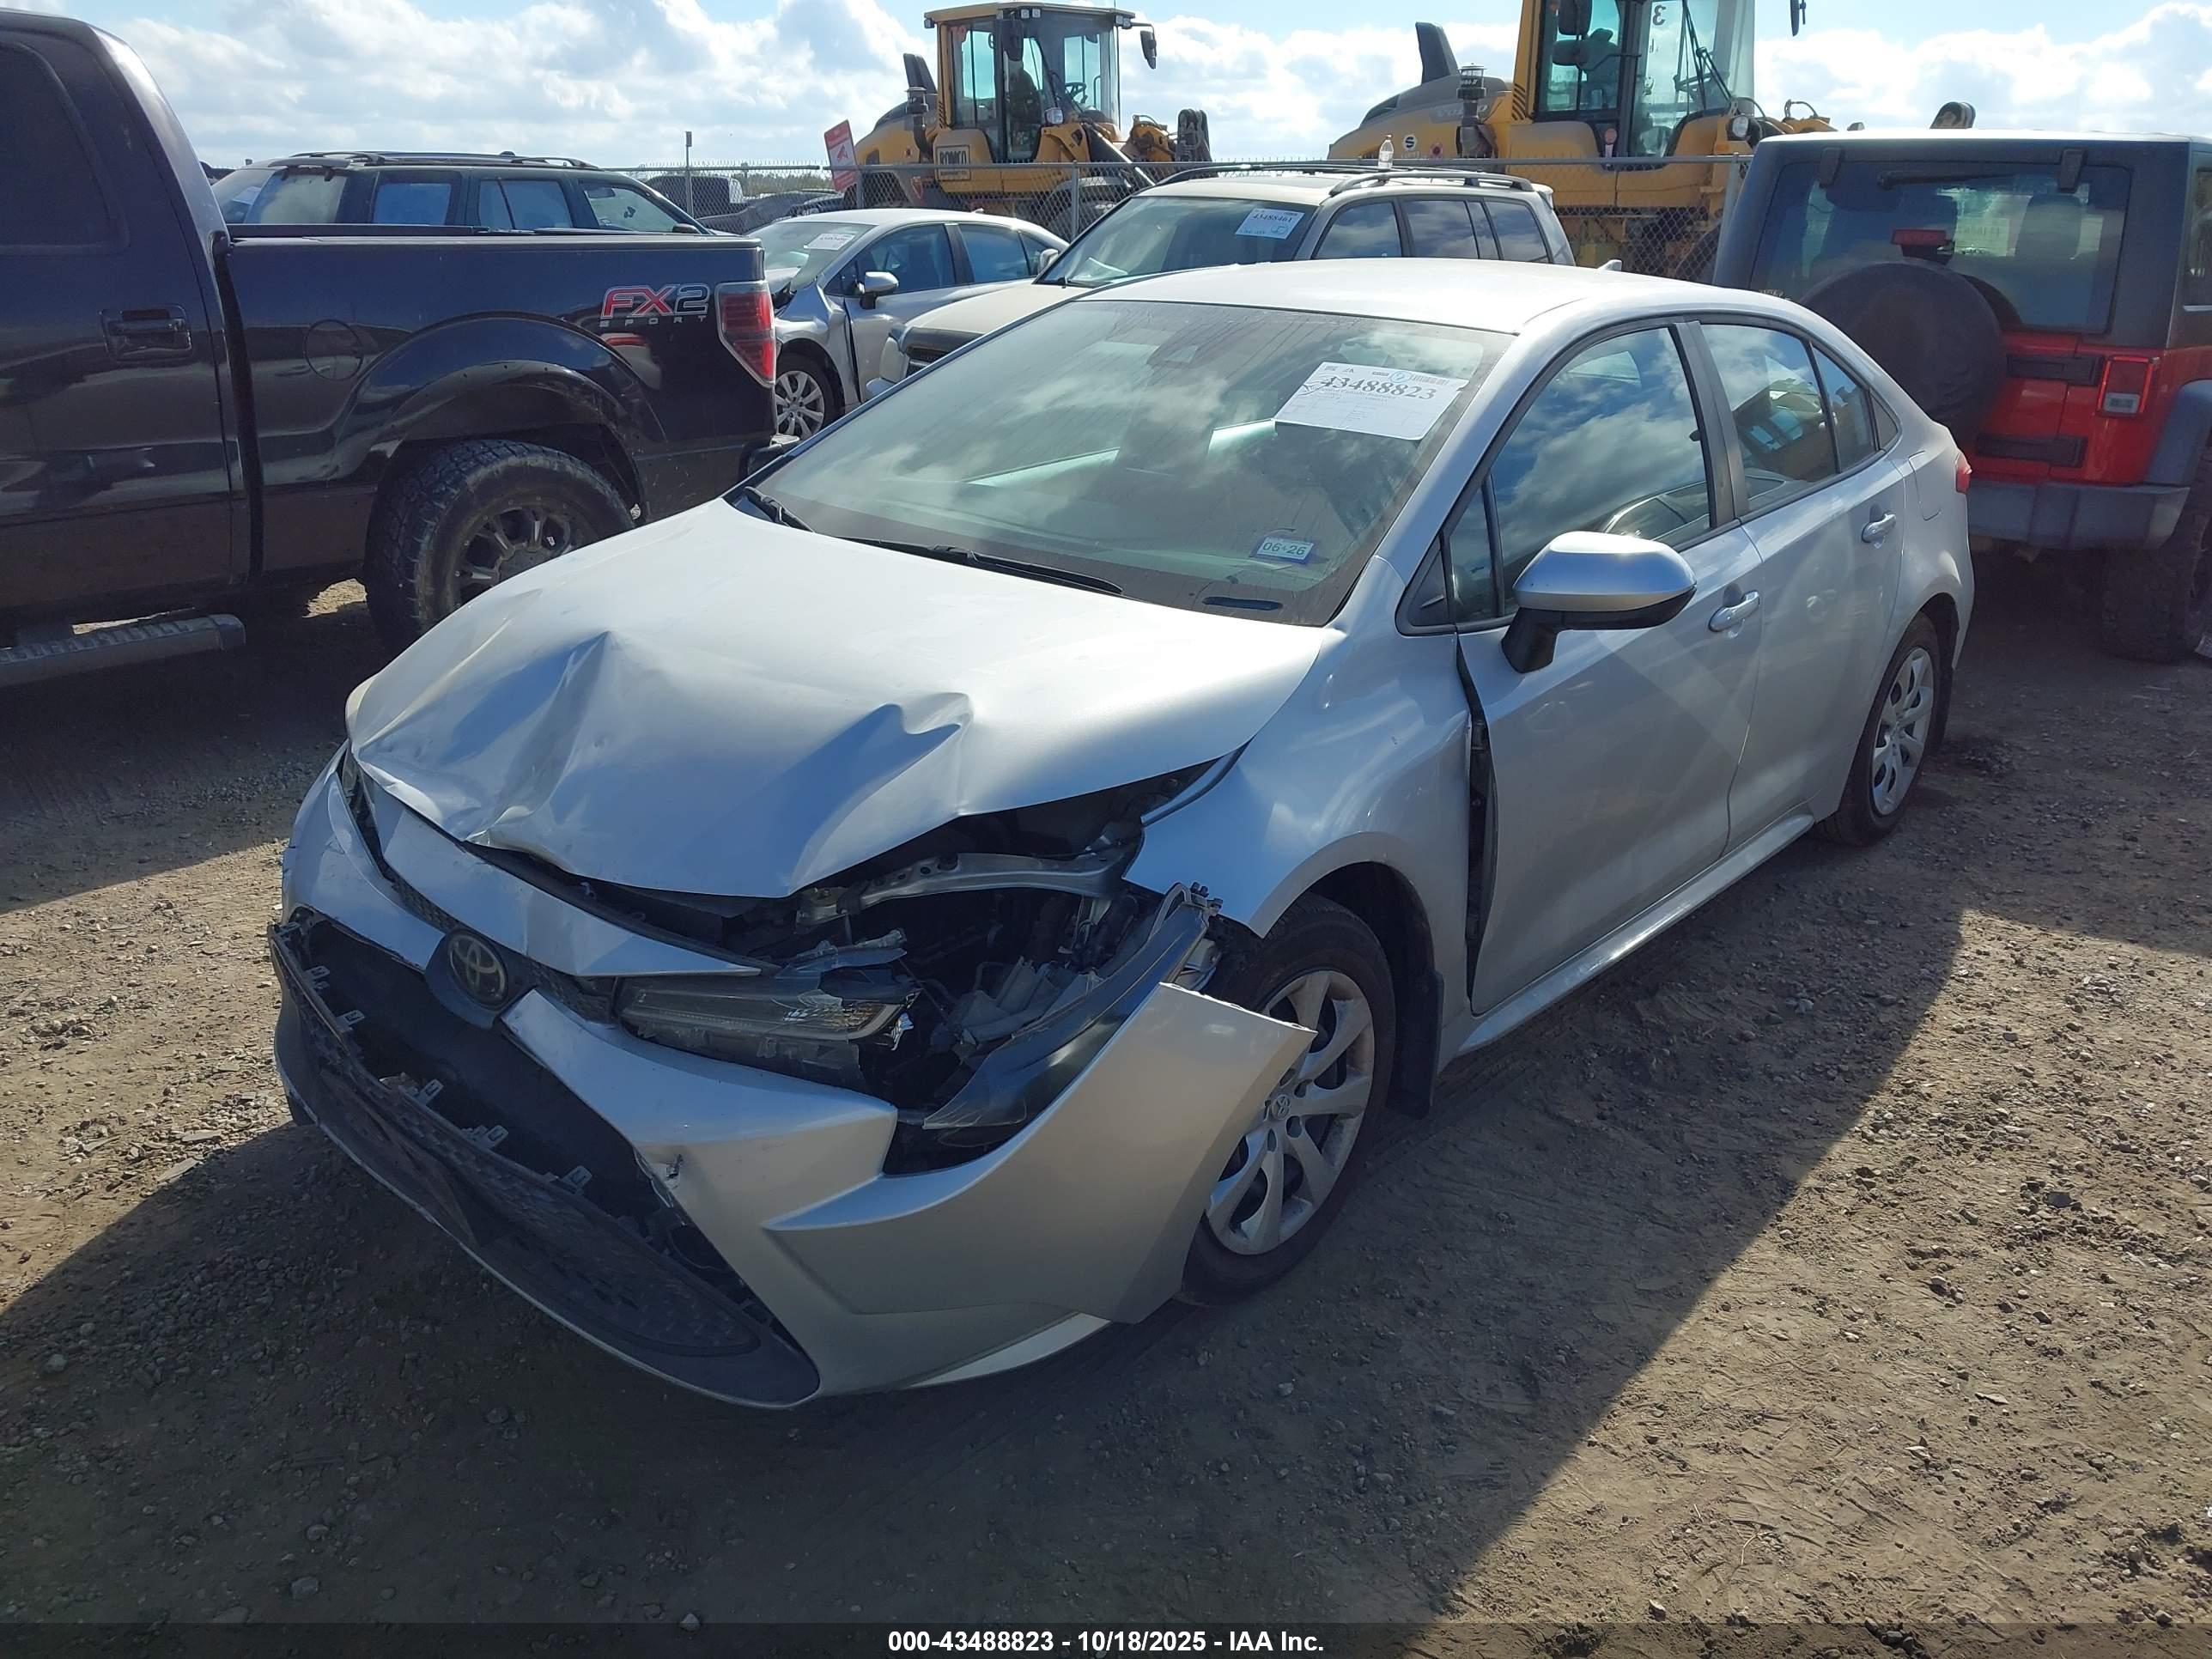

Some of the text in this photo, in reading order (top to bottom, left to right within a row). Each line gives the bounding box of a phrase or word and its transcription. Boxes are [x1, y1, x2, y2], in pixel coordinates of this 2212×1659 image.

[600, 283, 711, 320] FX2
[599, 316, 708, 328] SPORT
[1319, 375, 1437, 400] 43488823
